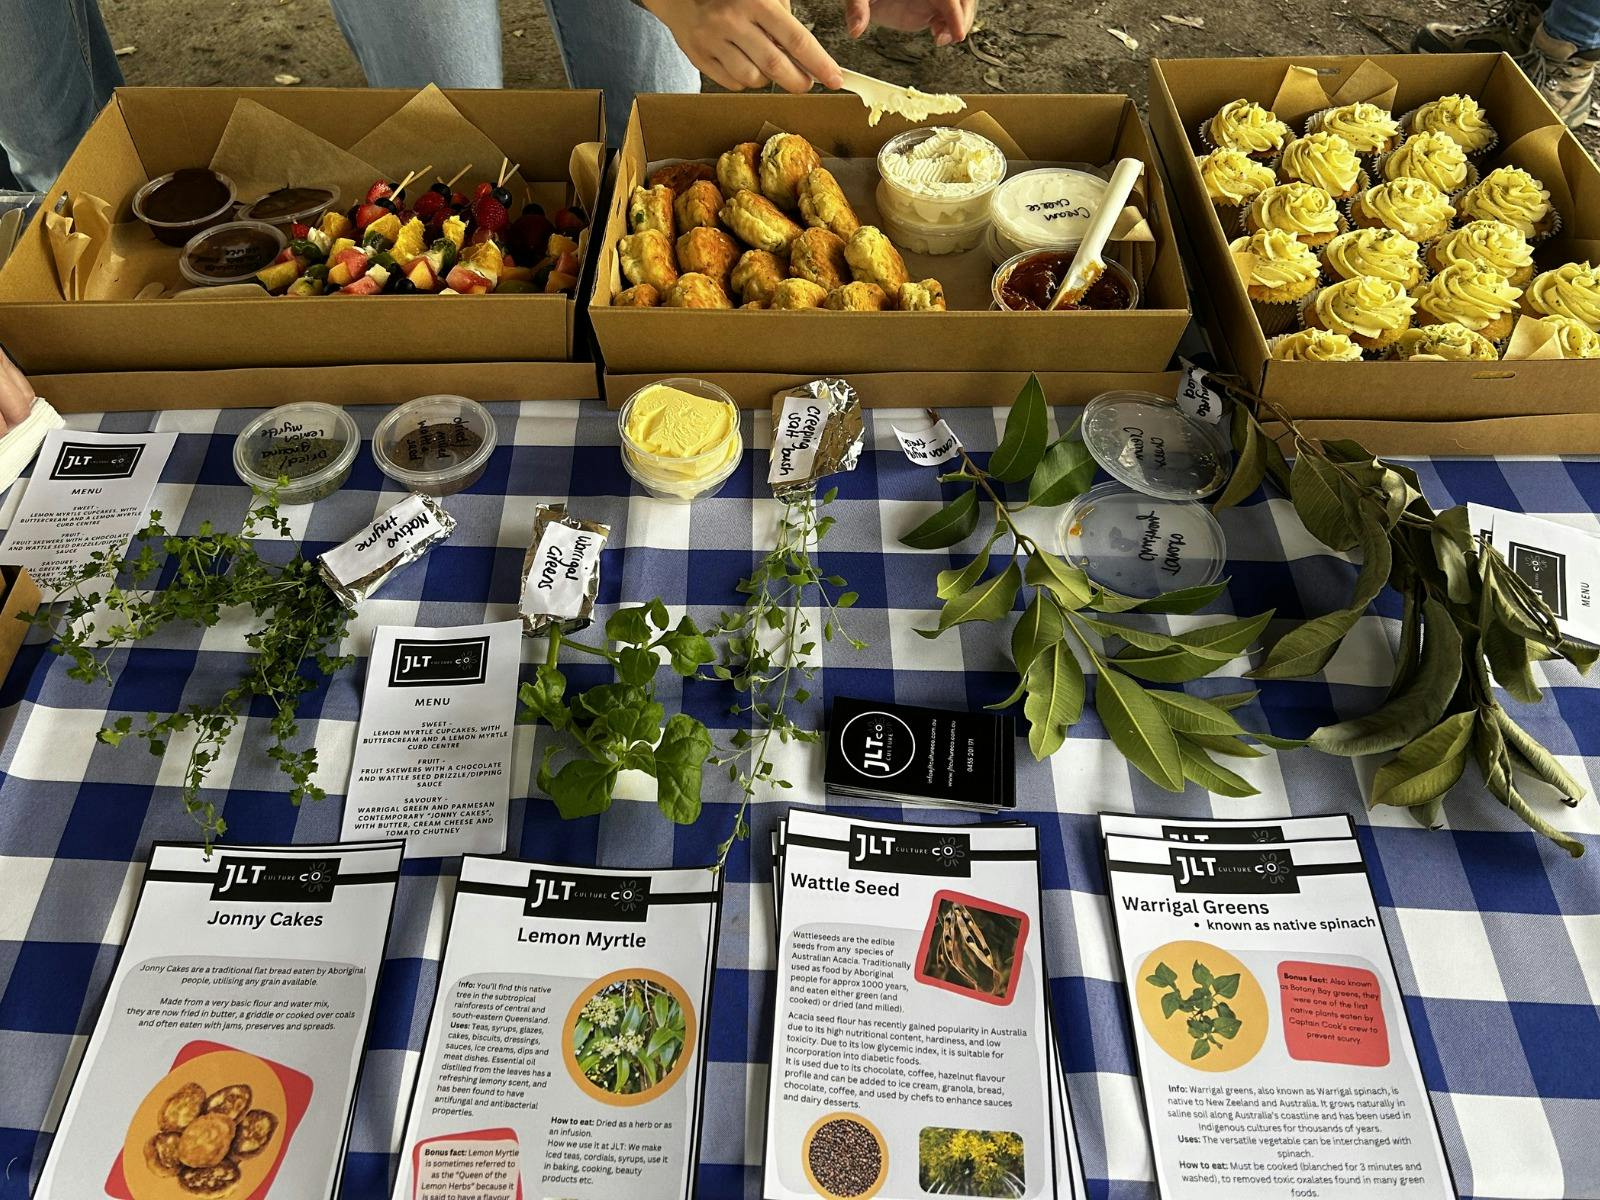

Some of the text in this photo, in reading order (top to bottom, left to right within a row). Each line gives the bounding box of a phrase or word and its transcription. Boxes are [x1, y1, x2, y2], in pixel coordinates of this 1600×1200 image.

[1043, 207, 1090, 221] Cream
[64, 456, 92, 469] JLT
[780, 448, 795, 475] bush
[387, 513, 429, 548] Native
[538, 546, 562, 589] Greens
[1581, 582, 1590, 607] MENU
[402, 656, 432, 673] JLT
[415, 698, 450, 706] MENU
[864, 737, 890, 771] JLT
[456, 762, 501, 770] CHOCOLATE
[855, 834, 895, 861] JLT
[219, 865, 266, 892] JLT
[1176, 857, 1216, 885] JLT
[531, 879, 576, 908] JLT
[791, 873, 899, 896] Wattle Seed
[1122, 896, 1269, 917] Warrigal Greens
[207, 911, 323, 930] Jonny Cakes
[1207, 916, 1376, 931] known as native spinach
[518, 928, 646, 950] Lemon Myrtle
[793, 931, 840, 942] Wattleseeds
[871, 938, 895, 946] edible
[140, 964, 166, 974] Jonny
[316, 968, 326, 976] by
[327, 967, 366, 976] Aboriginal
[792, 952, 831, 962] Australian
[862, 958, 911, 971] Traditionally
[1284, 972, 1307, 981] Bonus
[1309, 975, 1328, 984] fact:
[495, 994, 536, 1003] subtropical
[788, 1011, 814, 1021] Acacia
[837, 1016, 856, 1025] flour
[874, 1021, 907, 1029] recently
[909, 1023, 935, 1032] gained
[938, 1026, 979, 1035] popularity
[991, 1028, 1027, 1036] Australia
[448, 1032, 540, 1046] cakes, biscuits, dressings,
[1168, 1084, 1188, 1093] Info:
[1189, 1086, 1224, 1096] Warrigal
[1225, 1088, 1256, 1096] greens,
[1258, 1086, 1275, 1095] also
[1276, 1087, 1304, 1095] known
[1316, 1088, 1352, 1097] Warrigal
[1354, 1087, 1390, 1097] spinach,
